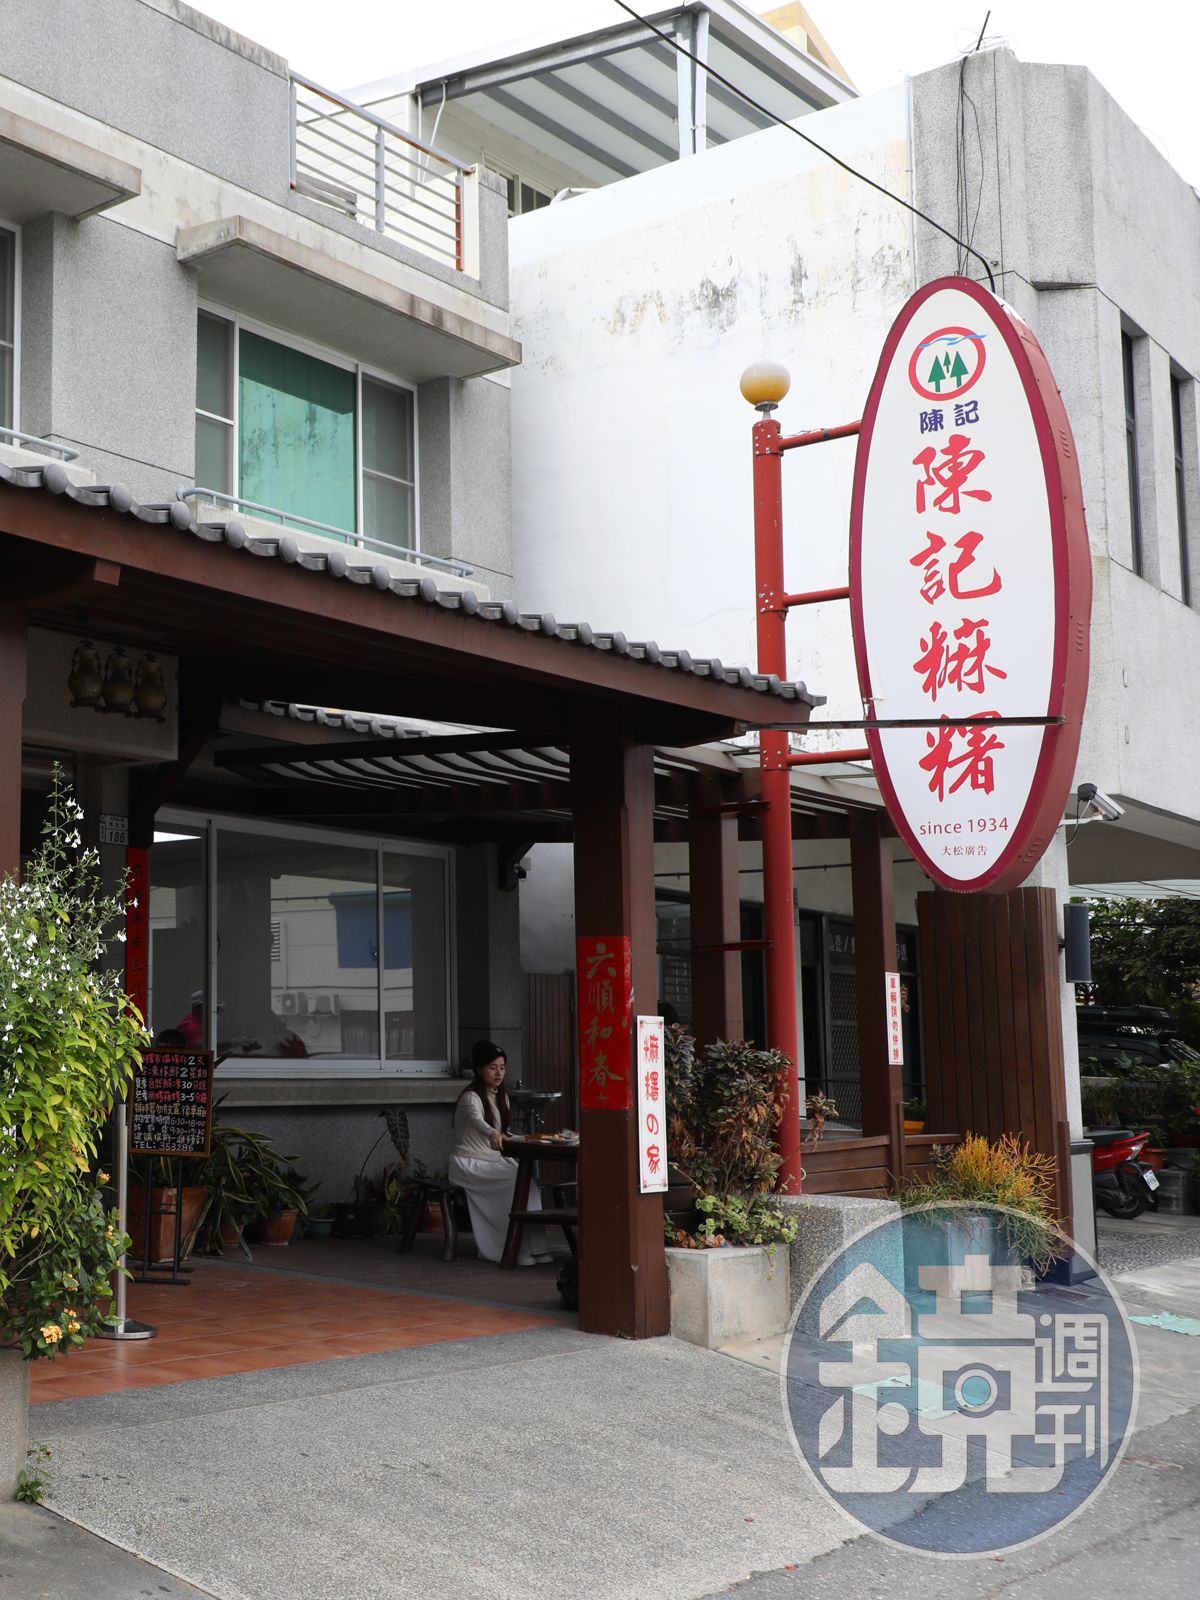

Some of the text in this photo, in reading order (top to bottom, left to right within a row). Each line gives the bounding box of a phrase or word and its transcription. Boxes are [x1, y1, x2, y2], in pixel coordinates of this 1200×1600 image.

[919, 401, 980, 434] 陳記
[919, 817, 1009, 834] since 1934
[109, 831, 126, 844] 186
[941, 844, 989, 858] 大松廣告
[585, 943, 623, 1087] 六順和春
